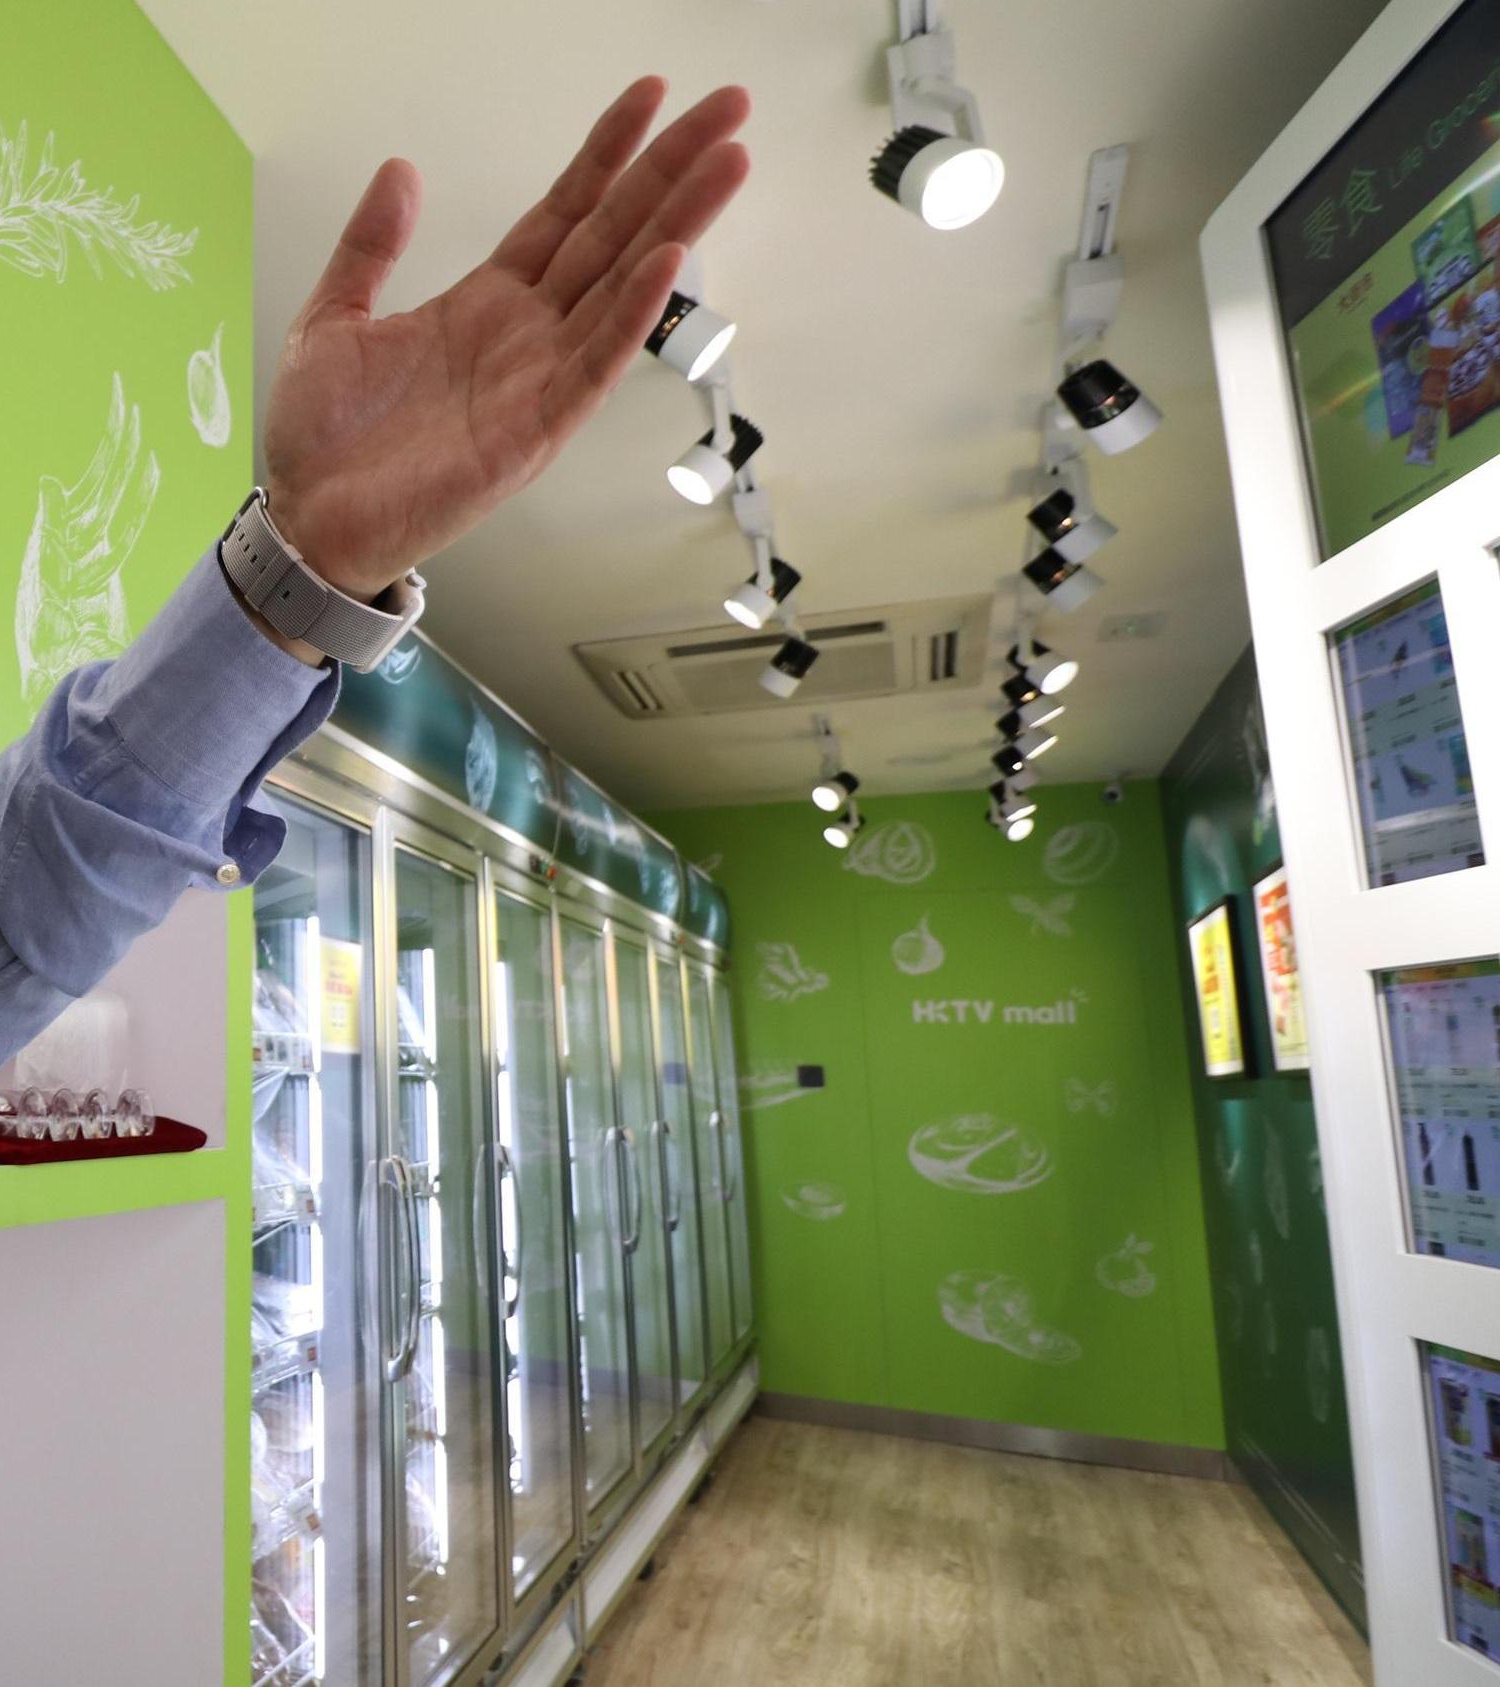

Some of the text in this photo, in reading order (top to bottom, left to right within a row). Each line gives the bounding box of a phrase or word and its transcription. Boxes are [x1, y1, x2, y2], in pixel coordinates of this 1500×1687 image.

[1302, 168, 1384, 261] 零食
[912, 1000, 1076, 1023] HKTV mall
